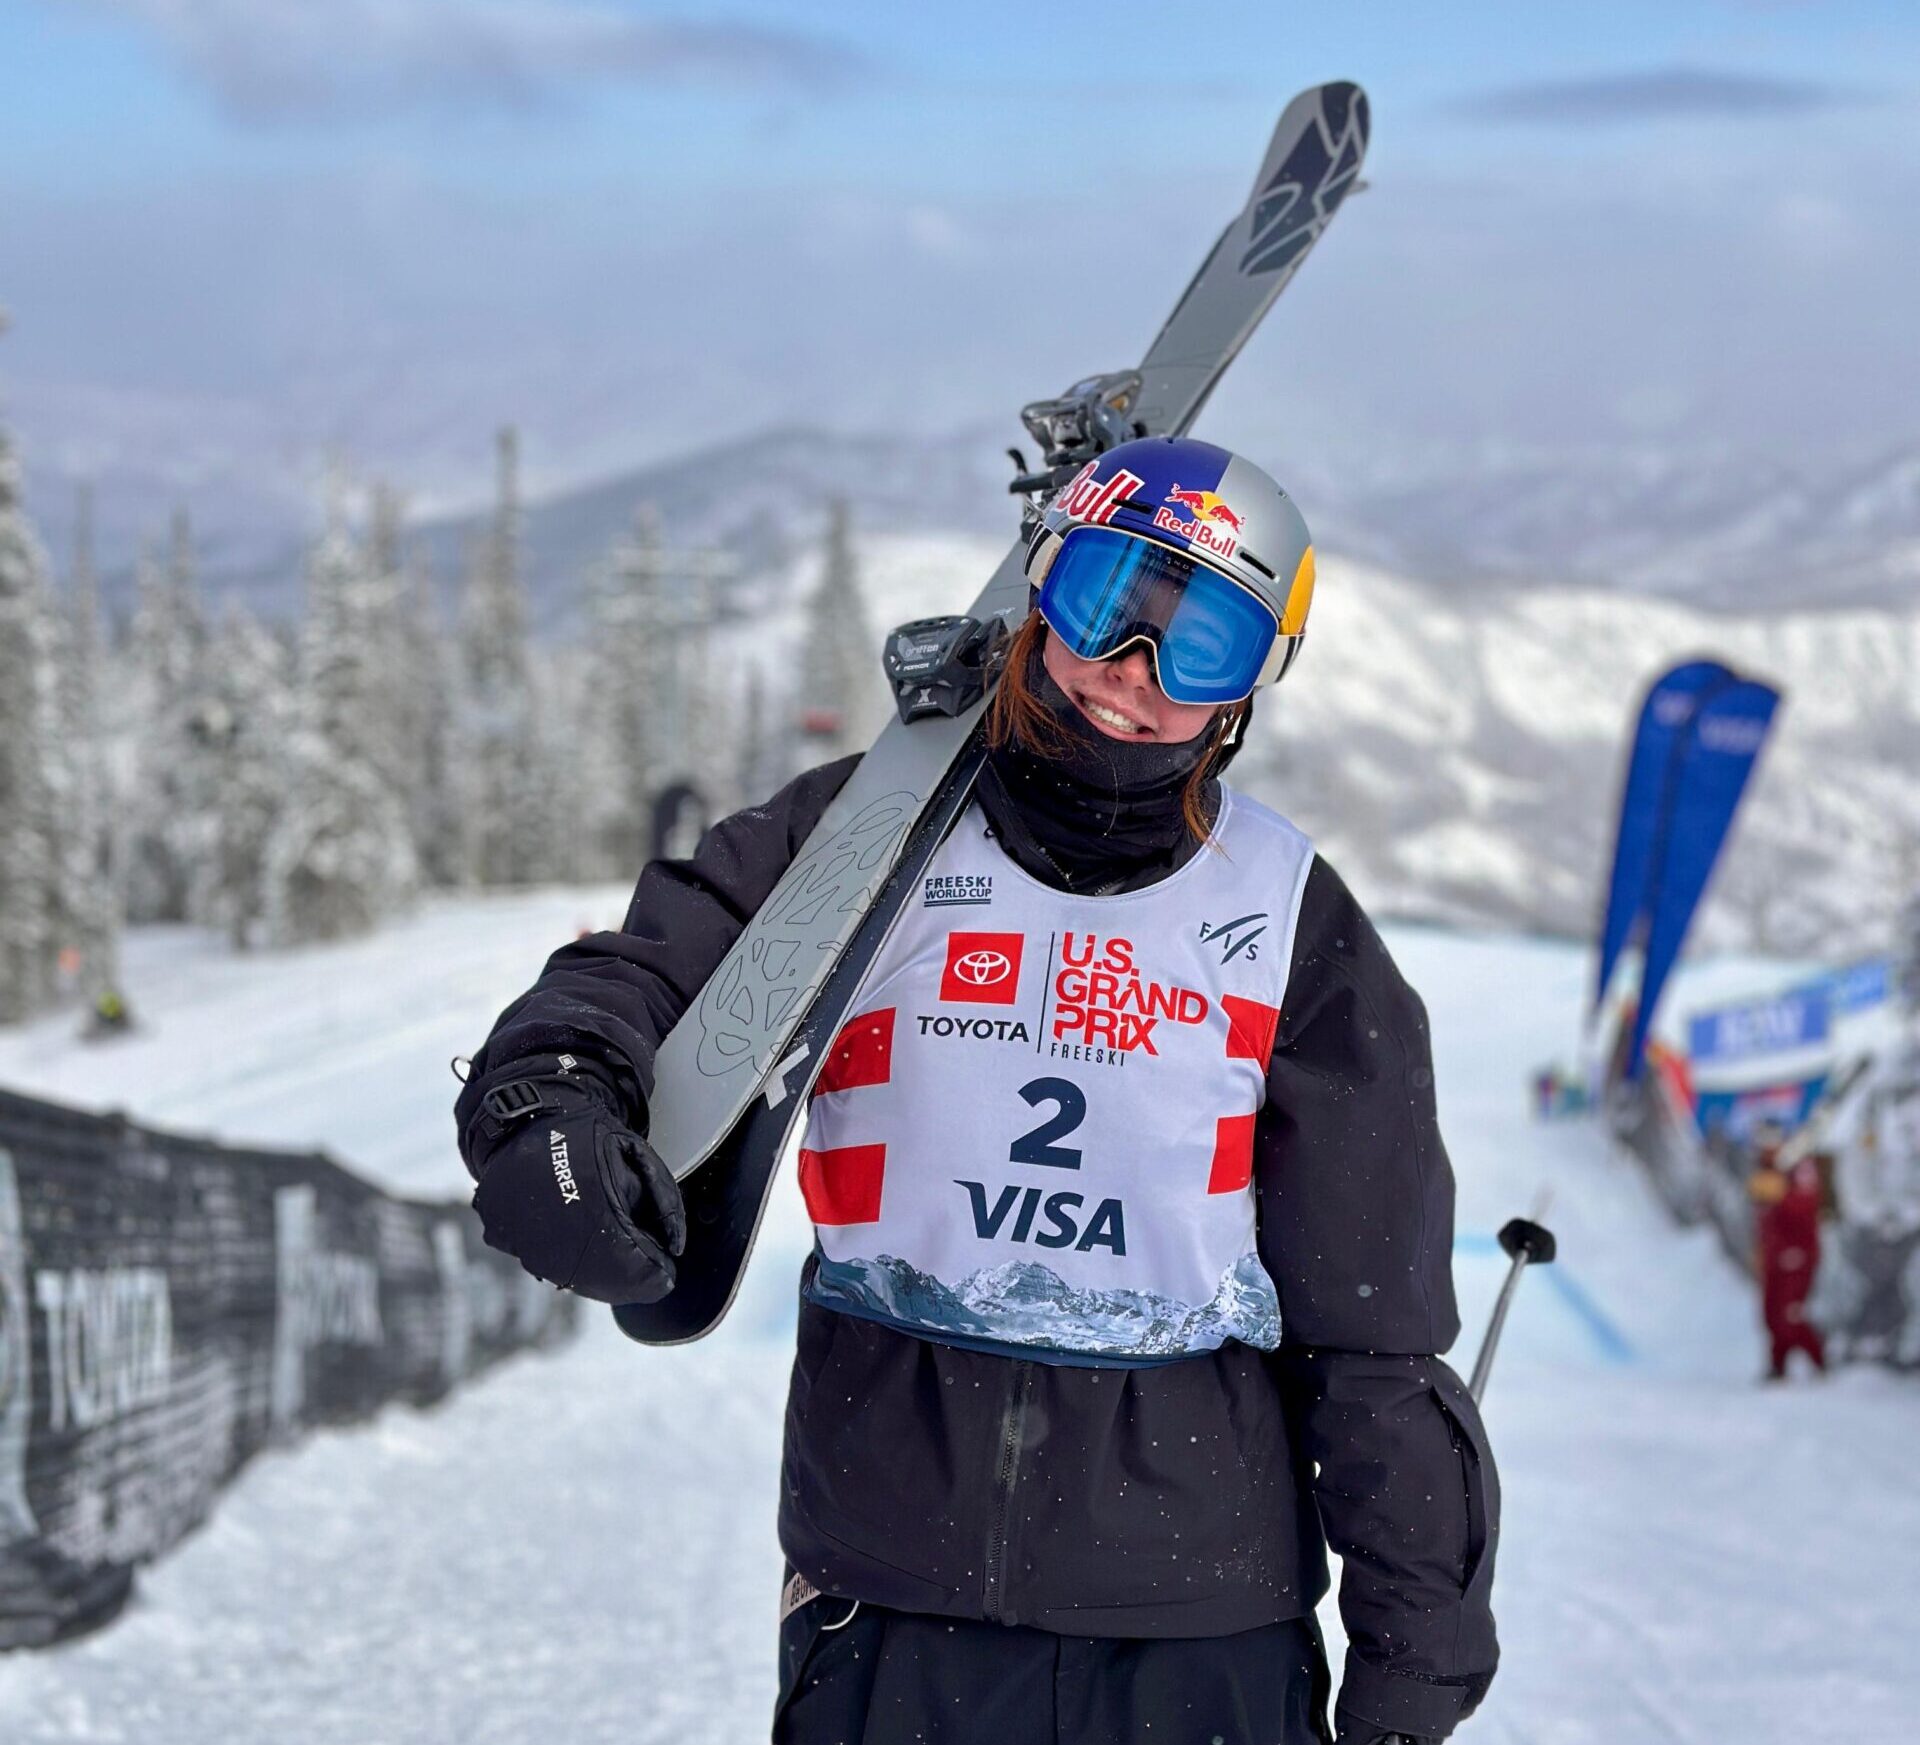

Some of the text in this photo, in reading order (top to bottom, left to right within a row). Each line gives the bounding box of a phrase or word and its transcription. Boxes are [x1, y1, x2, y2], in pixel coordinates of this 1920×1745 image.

[1056, 460, 1143, 526] Bull
[1154, 507, 1237, 558] Red Bull
[925, 876, 993, 889] FREESKI
[925, 886, 993, 900] WORLD CUP
[1062, 931, 1140, 977] U.S.
[1055, 968, 1209, 1025] GRAND
[916, 1015, 1030, 1043] TOYOTA
[1050, 1042, 1126, 1067] FREESKI
[1053, 1003, 1159, 1057] PRIX
[1009, 1076, 1087, 1171] 2
[550, 1142, 580, 1205] TERREX
[953, 1179, 1127, 1257] VISA
